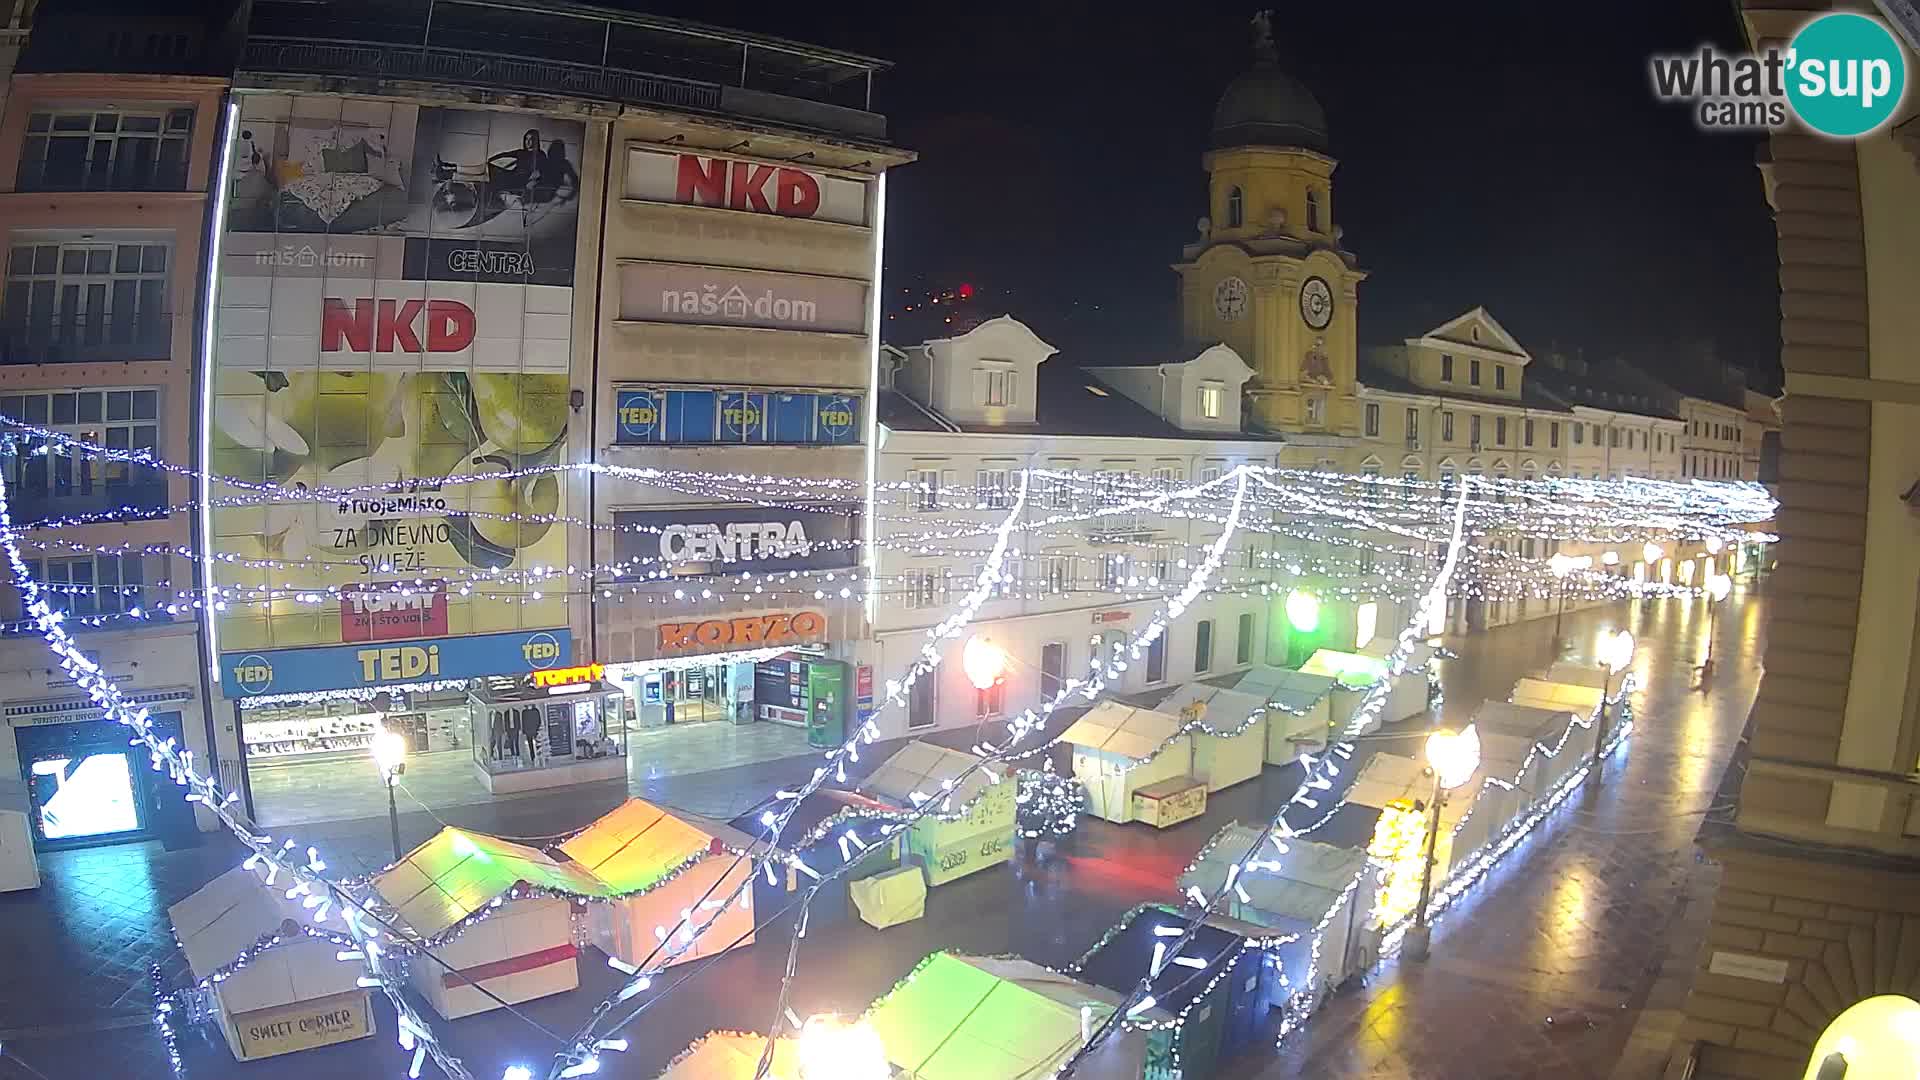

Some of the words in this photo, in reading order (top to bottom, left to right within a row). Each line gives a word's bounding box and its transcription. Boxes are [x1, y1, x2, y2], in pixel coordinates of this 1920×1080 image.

[676, 154, 820, 218] NKD
[255, 246, 294, 266] naš
[319, 247, 366, 267] dom
[448, 249, 535, 275] CENTRA
[662, 283, 718, 316] naš
[754, 289, 817, 322] dom
[321, 297, 477, 353] NKD
[619, 407, 658, 425] TEDi
[723, 408, 760, 425] TEDi
[820, 410, 853, 426] TEDi
[338, 496, 446, 517] #TvojeMisto
[333, 528, 358, 549] ZA
[368, 523, 450, 547] DNEVNO
[659, 520, 811, 563] CENTRA
[658, 611, 826, 651] KORZO
[233, 665, 273, 683] TEDi
[358, 644, 440, 682] TEDi
[522, 643, 560, 660] TEDi
[533, 663, 606, 689] TOMMY
[249, 1020, 293, 1041] SWEET
